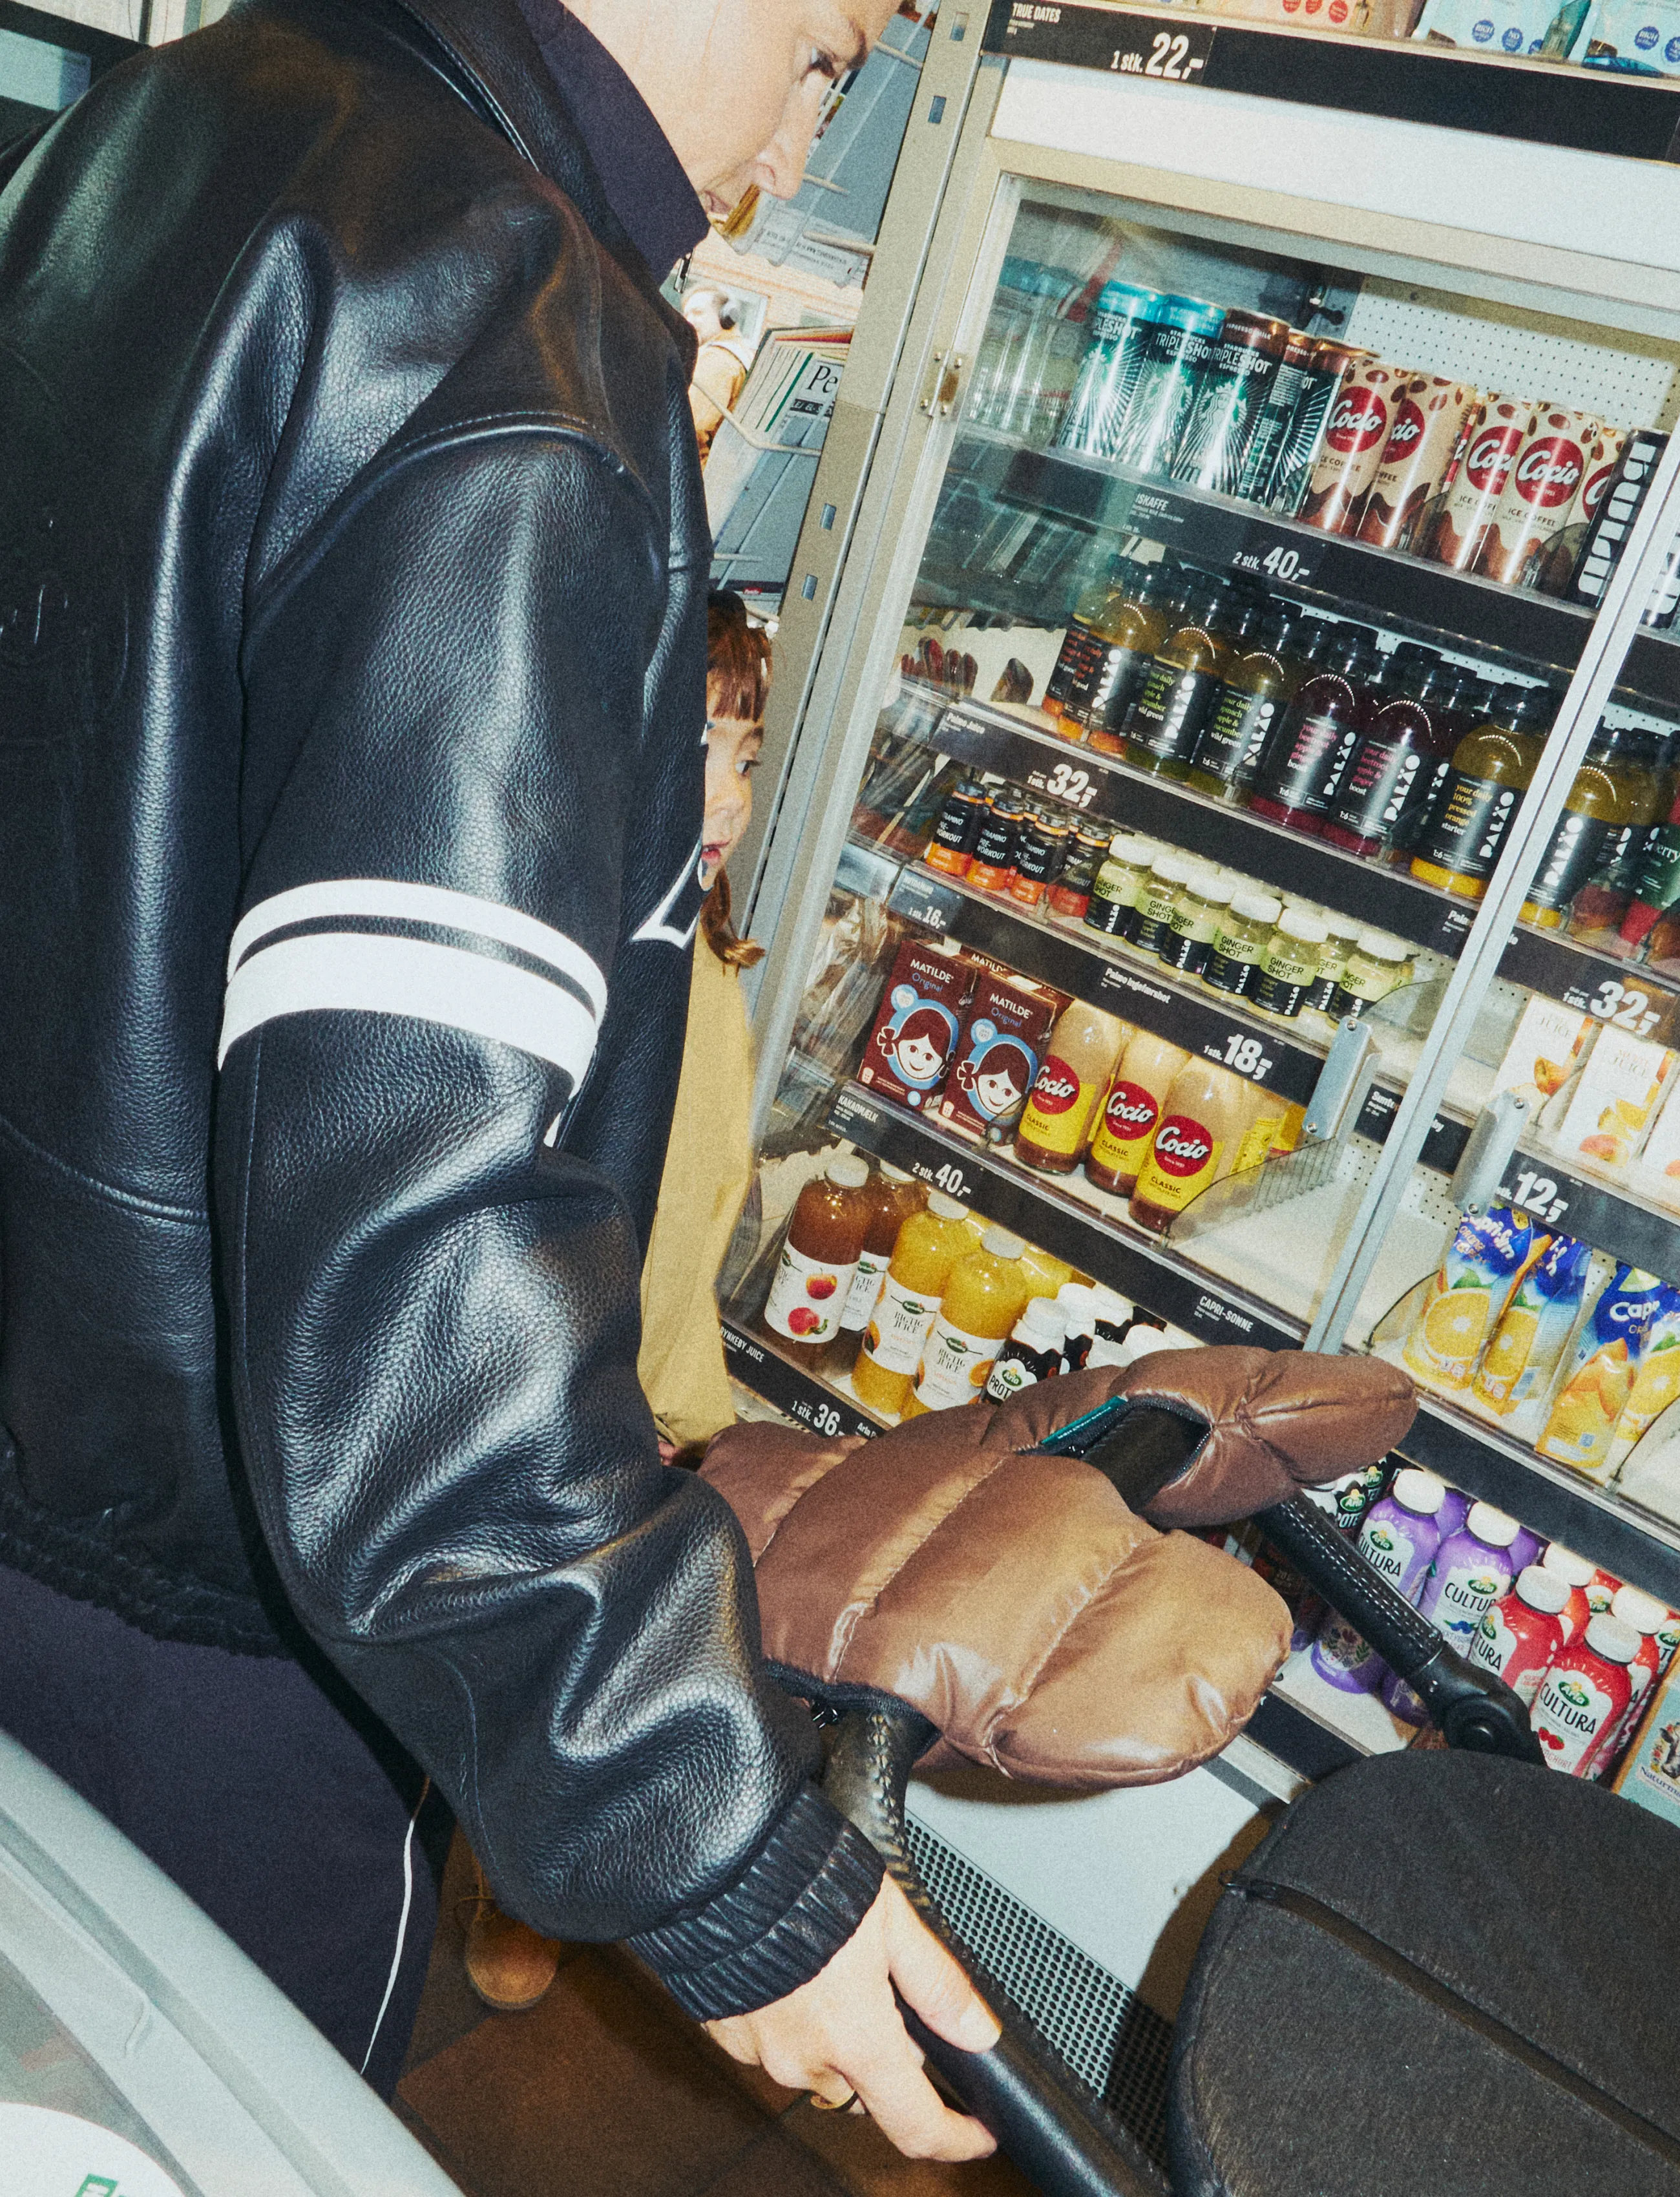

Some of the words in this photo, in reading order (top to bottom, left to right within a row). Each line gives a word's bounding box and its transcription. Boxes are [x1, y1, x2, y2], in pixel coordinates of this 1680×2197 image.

[1012, 3, 1033, 19] TRUE
[1033, 8, 1062, 23] DATES
[1111, 50, 1120, 69] 1
[1120, 52, 1143, 73] stk.
[1328, 400, 1382, 431] Cocio
[1391, 418, 1420, 441] cio
[1469, 439, 1515, 471] Coci
[1518, 450, 1579, 485] Cocio
[1135, 493, 1169, 511] ISKAFFE
[1507, 507, 1522, 516] ICE
[1232, 551, 1243, 565] 2
[1241, 554, 1259, 571] stk.
[1236, 700, 1254, 713] daily
[1146, 710, 1164, 722] green
[1221, 737, 1241, 748] green
[1349, 783, 1367, 795] boost
[1455, 784, 1472, 795] your
[1473, 789, 1493, 803] daily
[1453, 793, 1473, 806] 100%
[1445, 812, 1470, 827] orange
[1448, 803, 1477, 818] pressed
[1441, 823, 1467, 836] starter
[977, 845, 1006, 860] WORKOUT
[1433, 849, 1443, 859] 1:6
[1147, 908, 1173, 921] SHOT
[1150, 900, 1175, 914] GINGE
[1219, 944, 1242, 958] SHOT
[1221, 936, 1254, 954] GINGER
[910, 959, 952, 983] MATILDE
[1267, 965, 1292, 980] SHOT
[1270, 957, 1304, 975] GINGER
[912, 972, 943, 993] Original
[990, 993, 1032, 1019] MATILDE
[991, 1007, 1023, 1028] Original
[1034, 1066, 1075, 1098] Cocio
[838, 1095, 878, 1123] KAKAOMÆLK
[1107, 1091, 1155, 1122] Cocio
[1026, 1113, 1049, 1131] CLASSIC
[1101, 1139, 1129, 1157] CLASSIC
[1156, 1126, 1209, 1159] Cocio
[912, 1162, 920, 1173] 2
[918, 1166, 934, 1182] stk.
[1151, 1176, 1181, 1194] CLASSIC
[894, 1312, 923, 1327] RIGTIG
[1199, 1296, 1254, 1332] CAPRI-SONNE
[894, 1320, 918, 1334] JUICE
[720, 1326, 747, 1350] RYNKEBY
[746, 1346, 765, 1363] JUICE
[937, 1359, 960, 1374] JUICE
[938, 1348, 965, 1367] RIGTIG
[1003, 1370, 1020, 1384] Arla
[792, 1400, 797, 1411] 1
[797, 1405, 812, 1422] stk.
[1345, 1498, 1363, 1508] Arla
[1372, 1533, 1390, 1549] Arla
[1471, 1581, 1495, 1593] Arla
[1561, 1685, 1585, 1705] Arla
[1540, 1683, 1596, 1734] CULTURA
